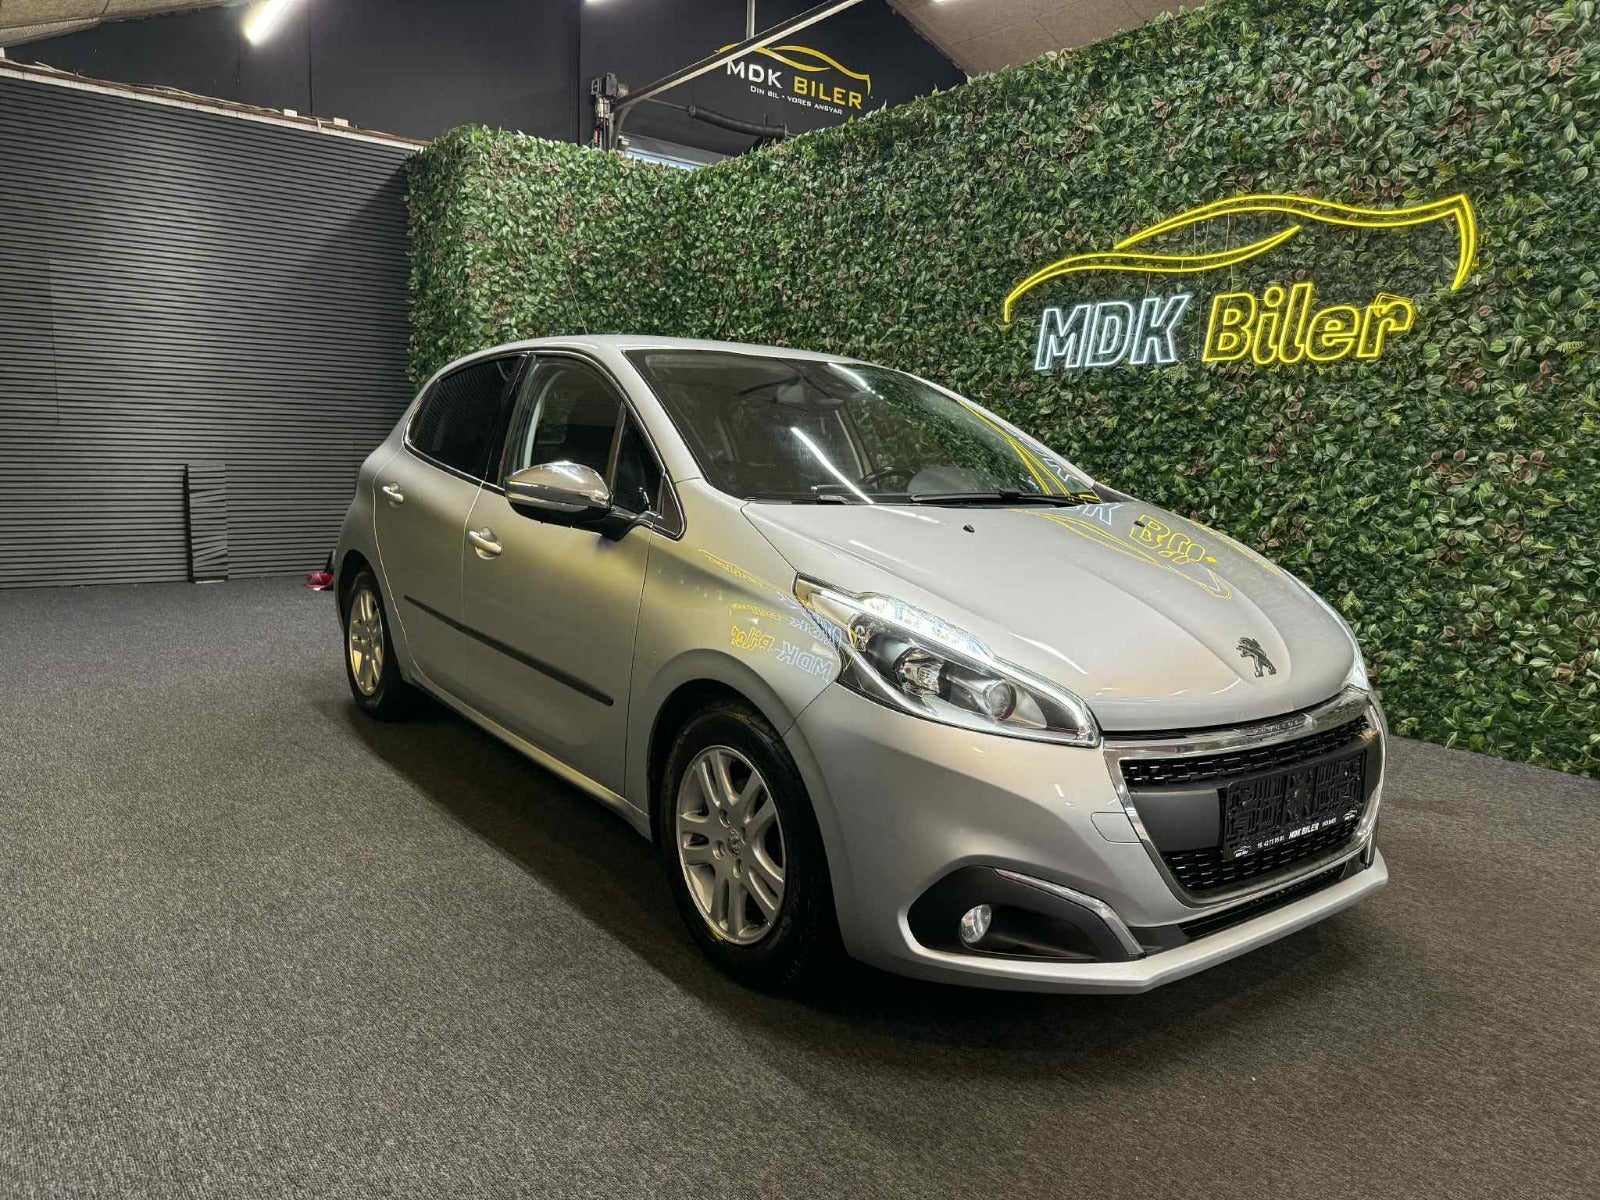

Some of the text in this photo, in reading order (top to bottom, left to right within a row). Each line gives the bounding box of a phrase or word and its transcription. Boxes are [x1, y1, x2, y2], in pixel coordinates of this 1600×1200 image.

[726, 60, 862, 110] MDK BILER
[767, 90, 780, 99] BIL
[787, 95, 812, 107] VORES
[813, 103, 843, 115] ANSVAR
[1034, 281, 1415, 371] MDK Biler
[1301, 822, 1320, 836] BILER
